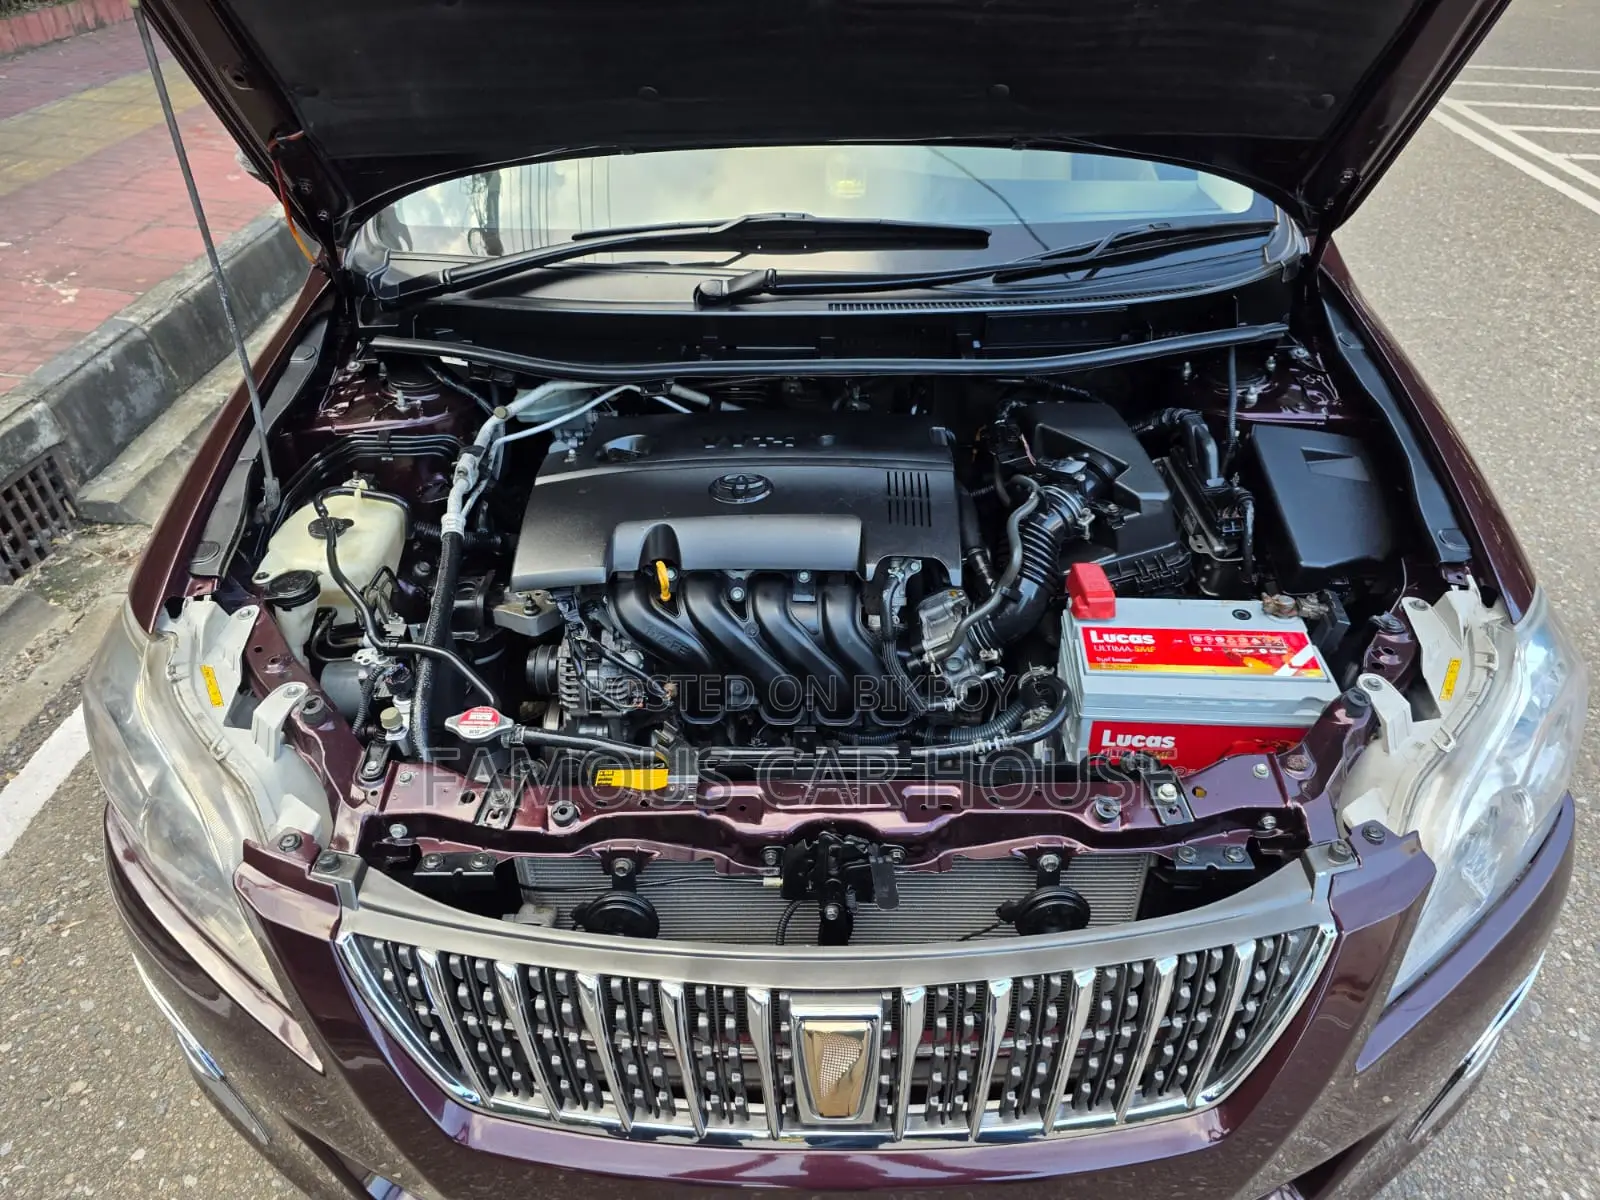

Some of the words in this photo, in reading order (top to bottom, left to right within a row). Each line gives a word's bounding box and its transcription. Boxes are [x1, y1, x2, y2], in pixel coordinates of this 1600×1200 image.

[1089, 629, 1156, 645] Lucas
[1093, 645, 1133, 653] ULTIMA
[1133, 645, 1157, 653] SMF
[1101, 729, 1176, 749] Lucas
